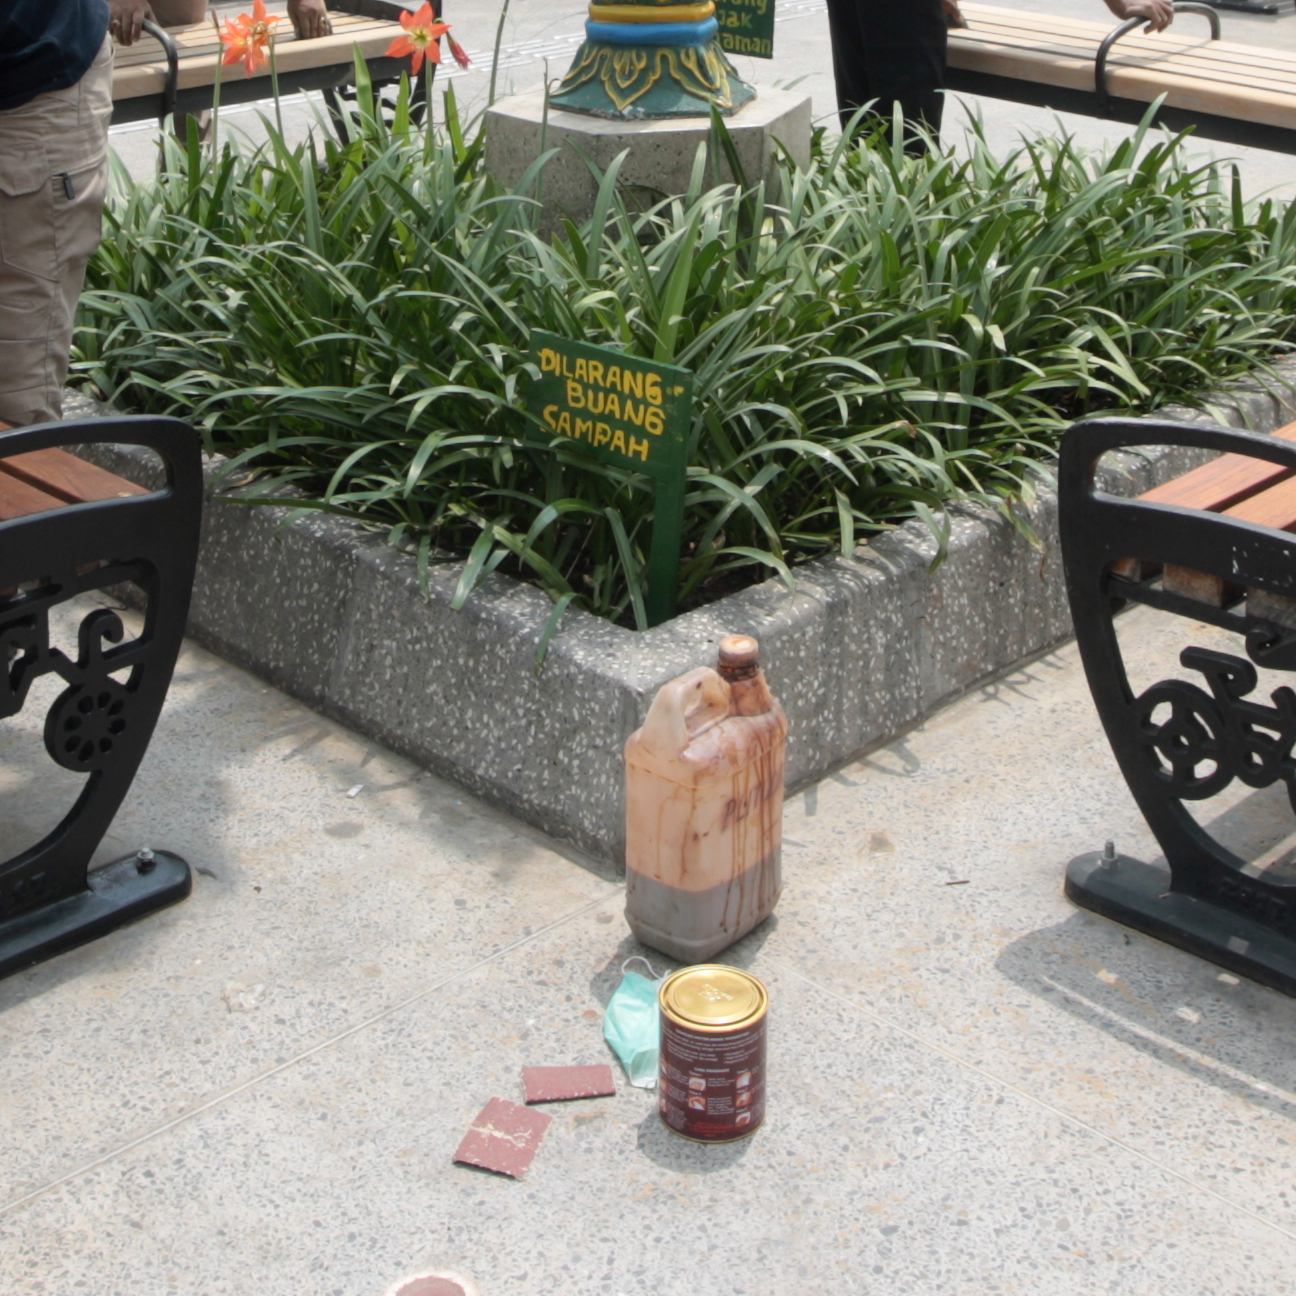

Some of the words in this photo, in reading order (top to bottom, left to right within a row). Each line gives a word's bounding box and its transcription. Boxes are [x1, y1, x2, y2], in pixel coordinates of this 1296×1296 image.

[537, 348, 663, 405] DILARANG
[540, 404, 649, 462] SAMPAH
[567, 378, 665, 435] BUANG
